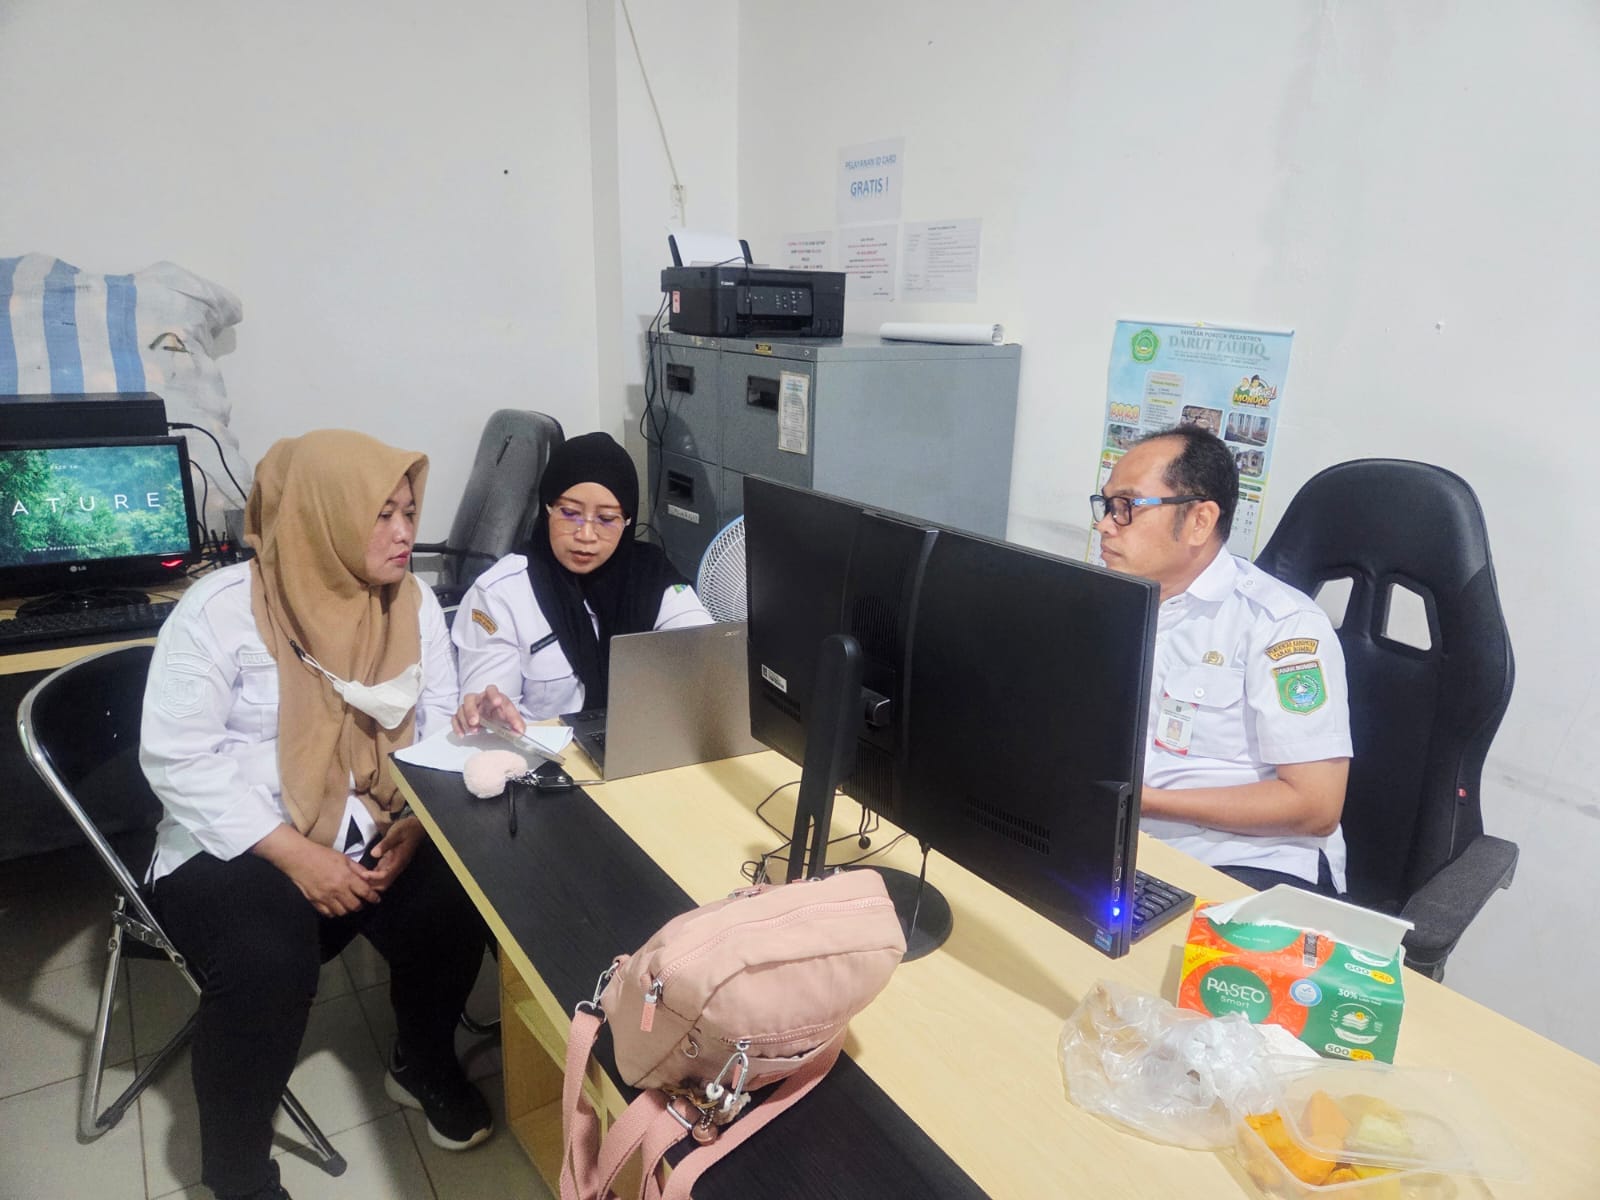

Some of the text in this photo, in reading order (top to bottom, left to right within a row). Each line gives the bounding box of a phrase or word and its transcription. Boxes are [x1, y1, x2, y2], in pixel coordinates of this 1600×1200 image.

[850, 178, 883, 197] GRATIS
[1169, 335, 1214, 350] DARUT
[1207, 977, 1265, 1004] PASEO
[1338, 988, 1358, 1000] 30%
[1327, 1044, 1350, 1055] 500
